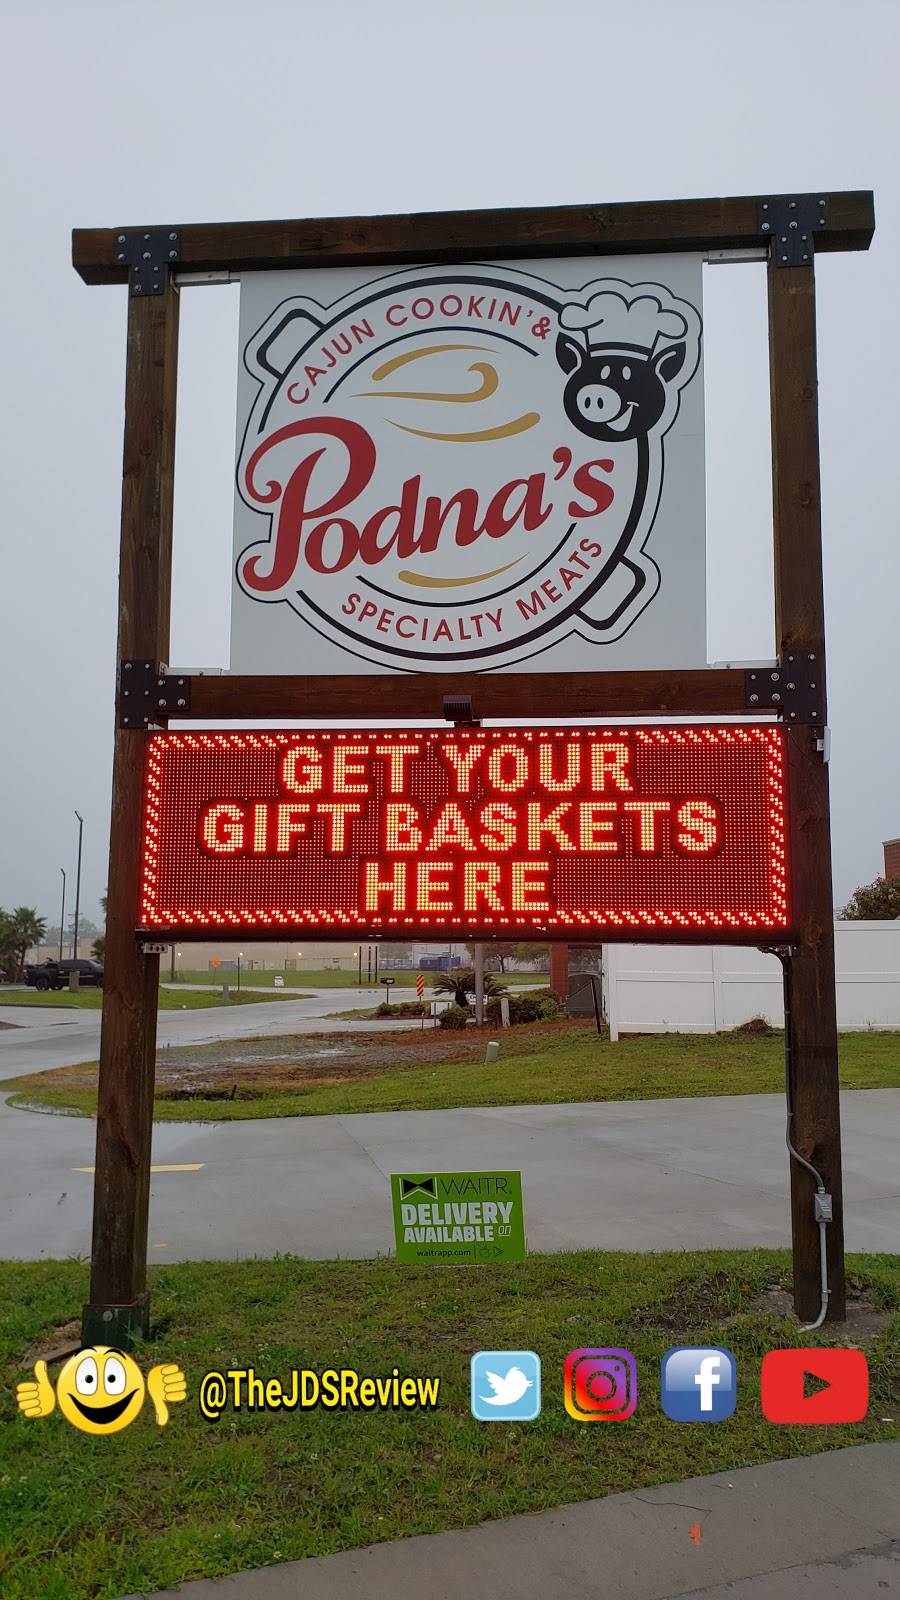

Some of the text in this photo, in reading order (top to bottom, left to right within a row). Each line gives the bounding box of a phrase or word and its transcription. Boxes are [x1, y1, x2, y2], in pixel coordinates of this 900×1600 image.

[287, 319, 376, 405] CAJUN
[243, 416, 615, 592] Podna's
[341, 537, 602, 642] SPECIALTY MEATS
[282, 742, 633, 794] GET YOUR
[203, 799, 718, 853] GIFT BASKETS
[365, 861, 550, 912] HERE
[401, 1202, 513, 1225] DELIVERY
[404, 1226, 494, 1243] AVAILABLE
[416, 1249, 471, 1257] waitrapp.com
